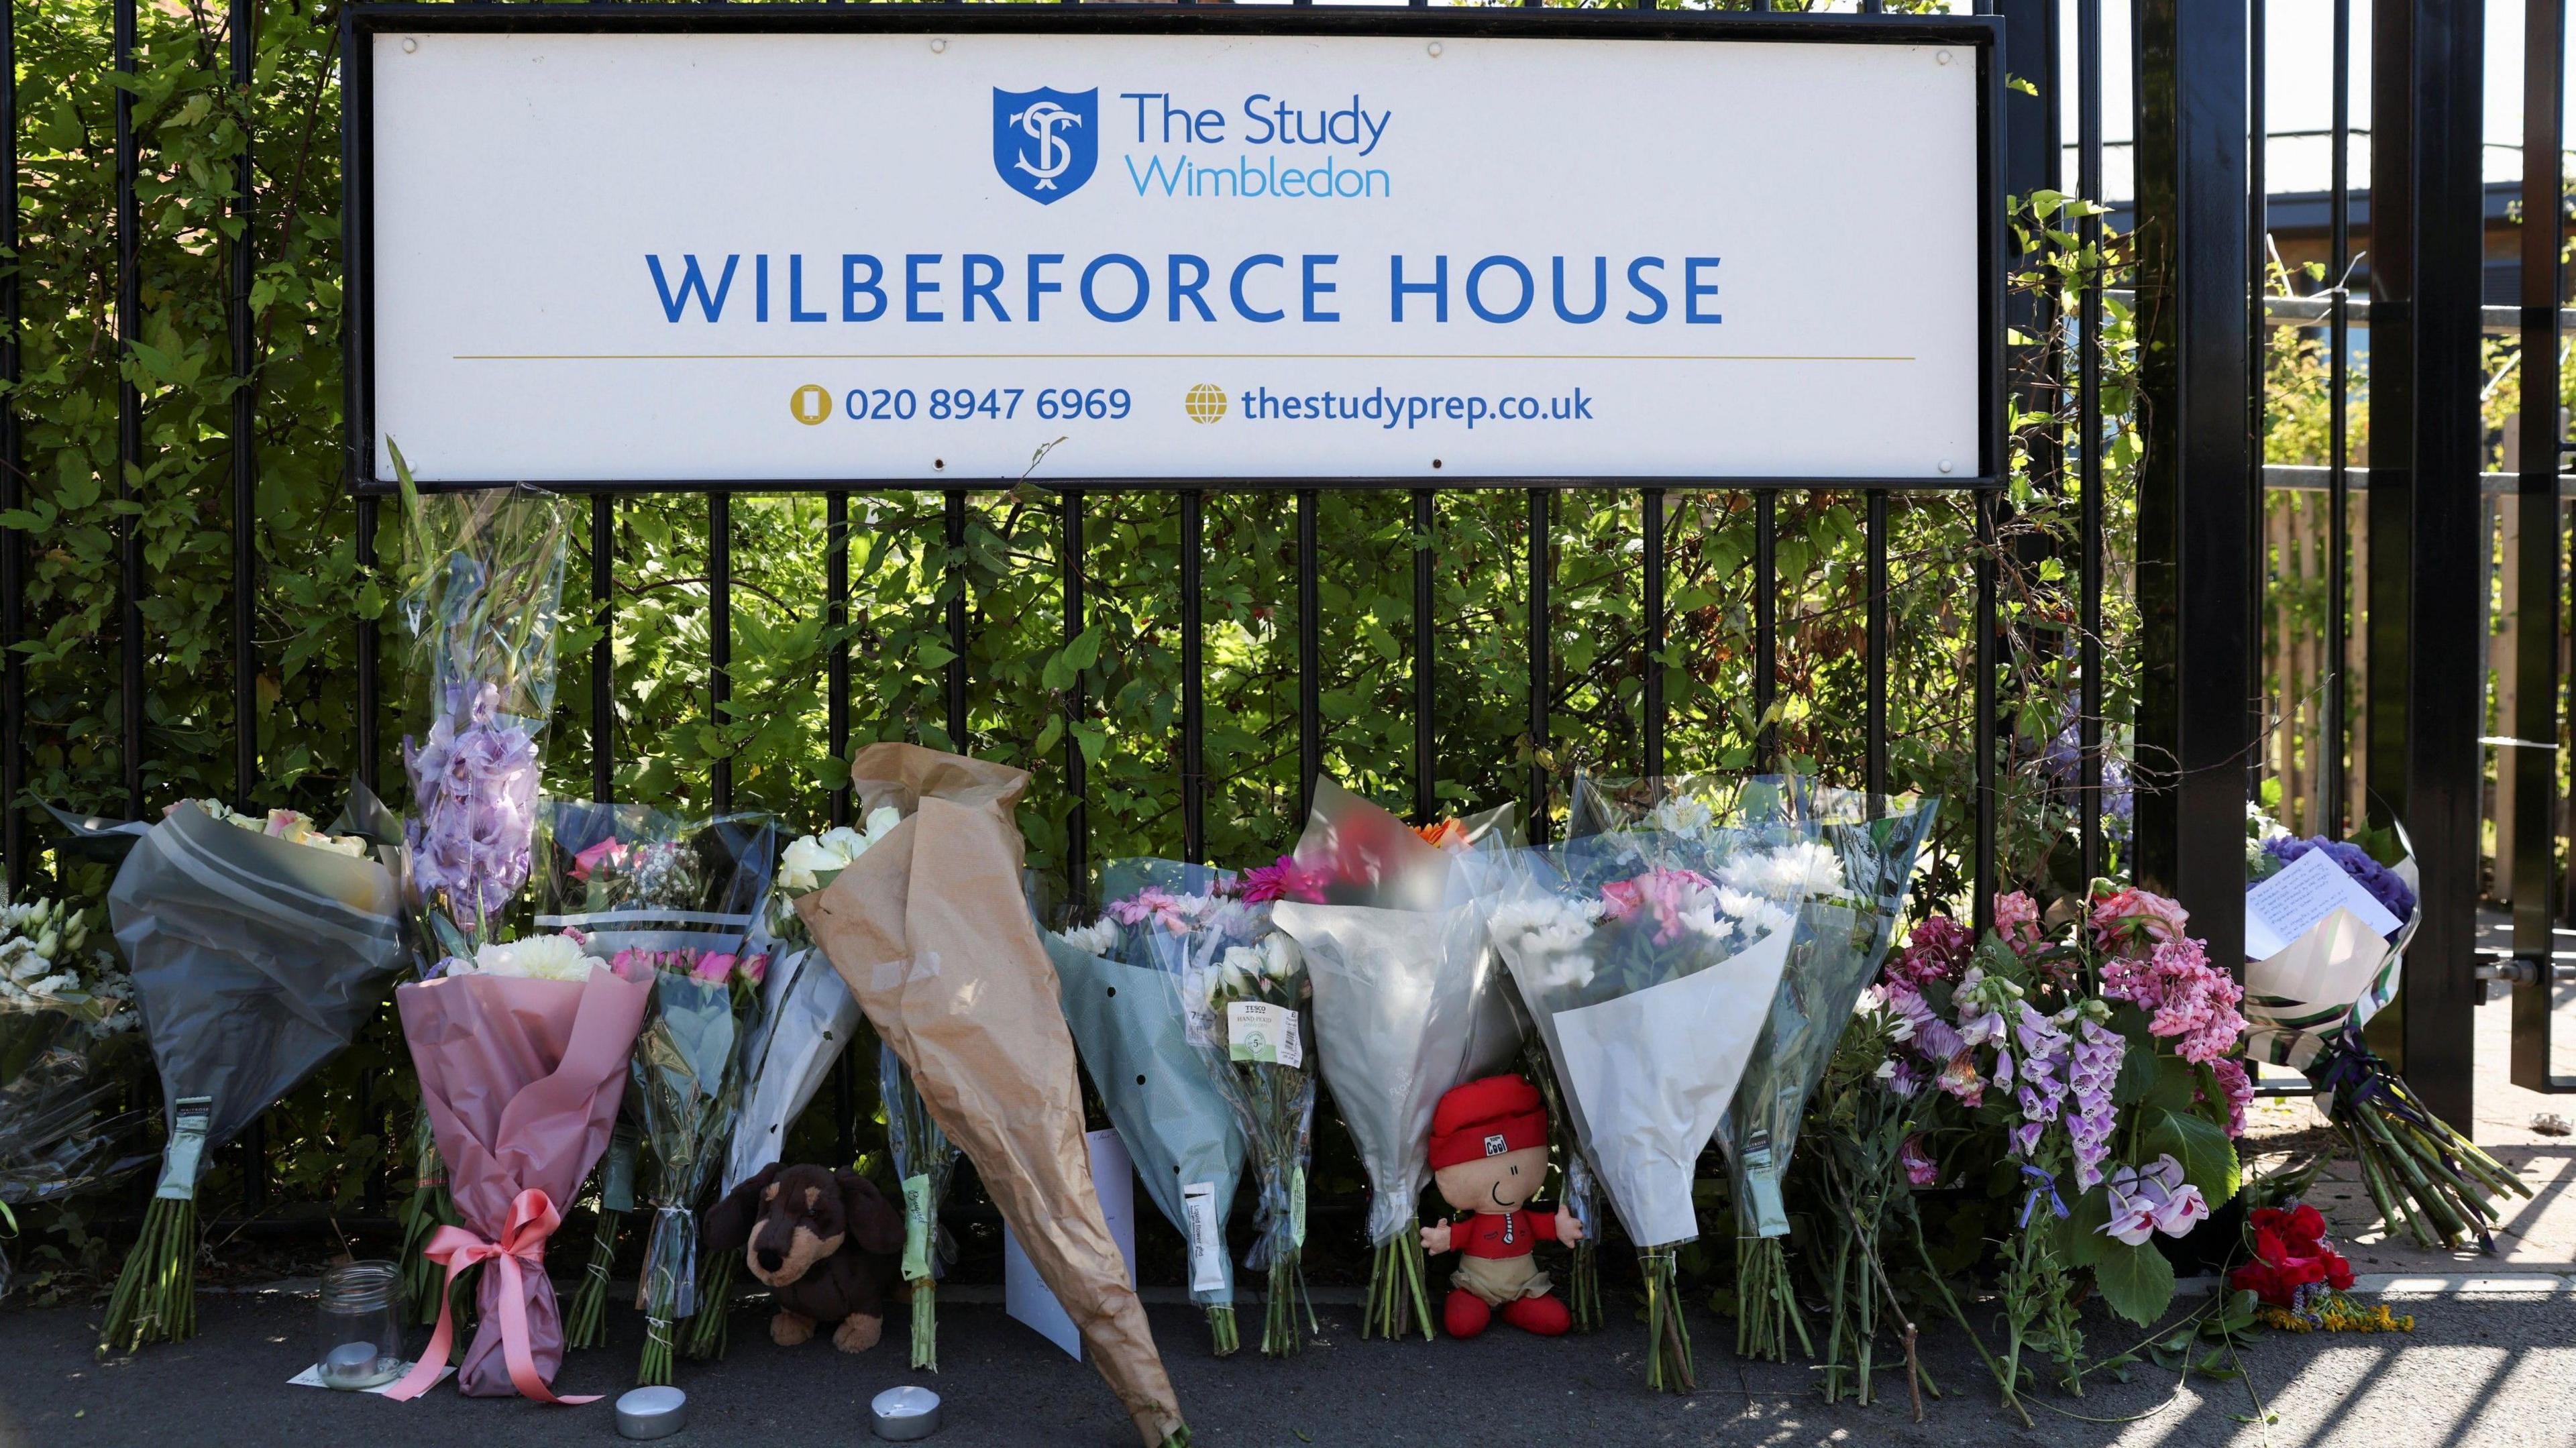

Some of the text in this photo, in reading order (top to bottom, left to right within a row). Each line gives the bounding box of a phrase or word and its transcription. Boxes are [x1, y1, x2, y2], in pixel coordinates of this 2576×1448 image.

[1120, 93, 1391, 156] The Study
[1125, 155, 1390, 197] Wimbledon
[645, 254, 1721, 324] WILBERFORCE HOUSE
[846, 389, 1130, 420] 020 8947 6969
[1242, 387, 1593, 429] thestudyprep.co.uk
[1253, 1039, 1258, 1048] 5
[1487, 1139, 1507, 1155] Cool
